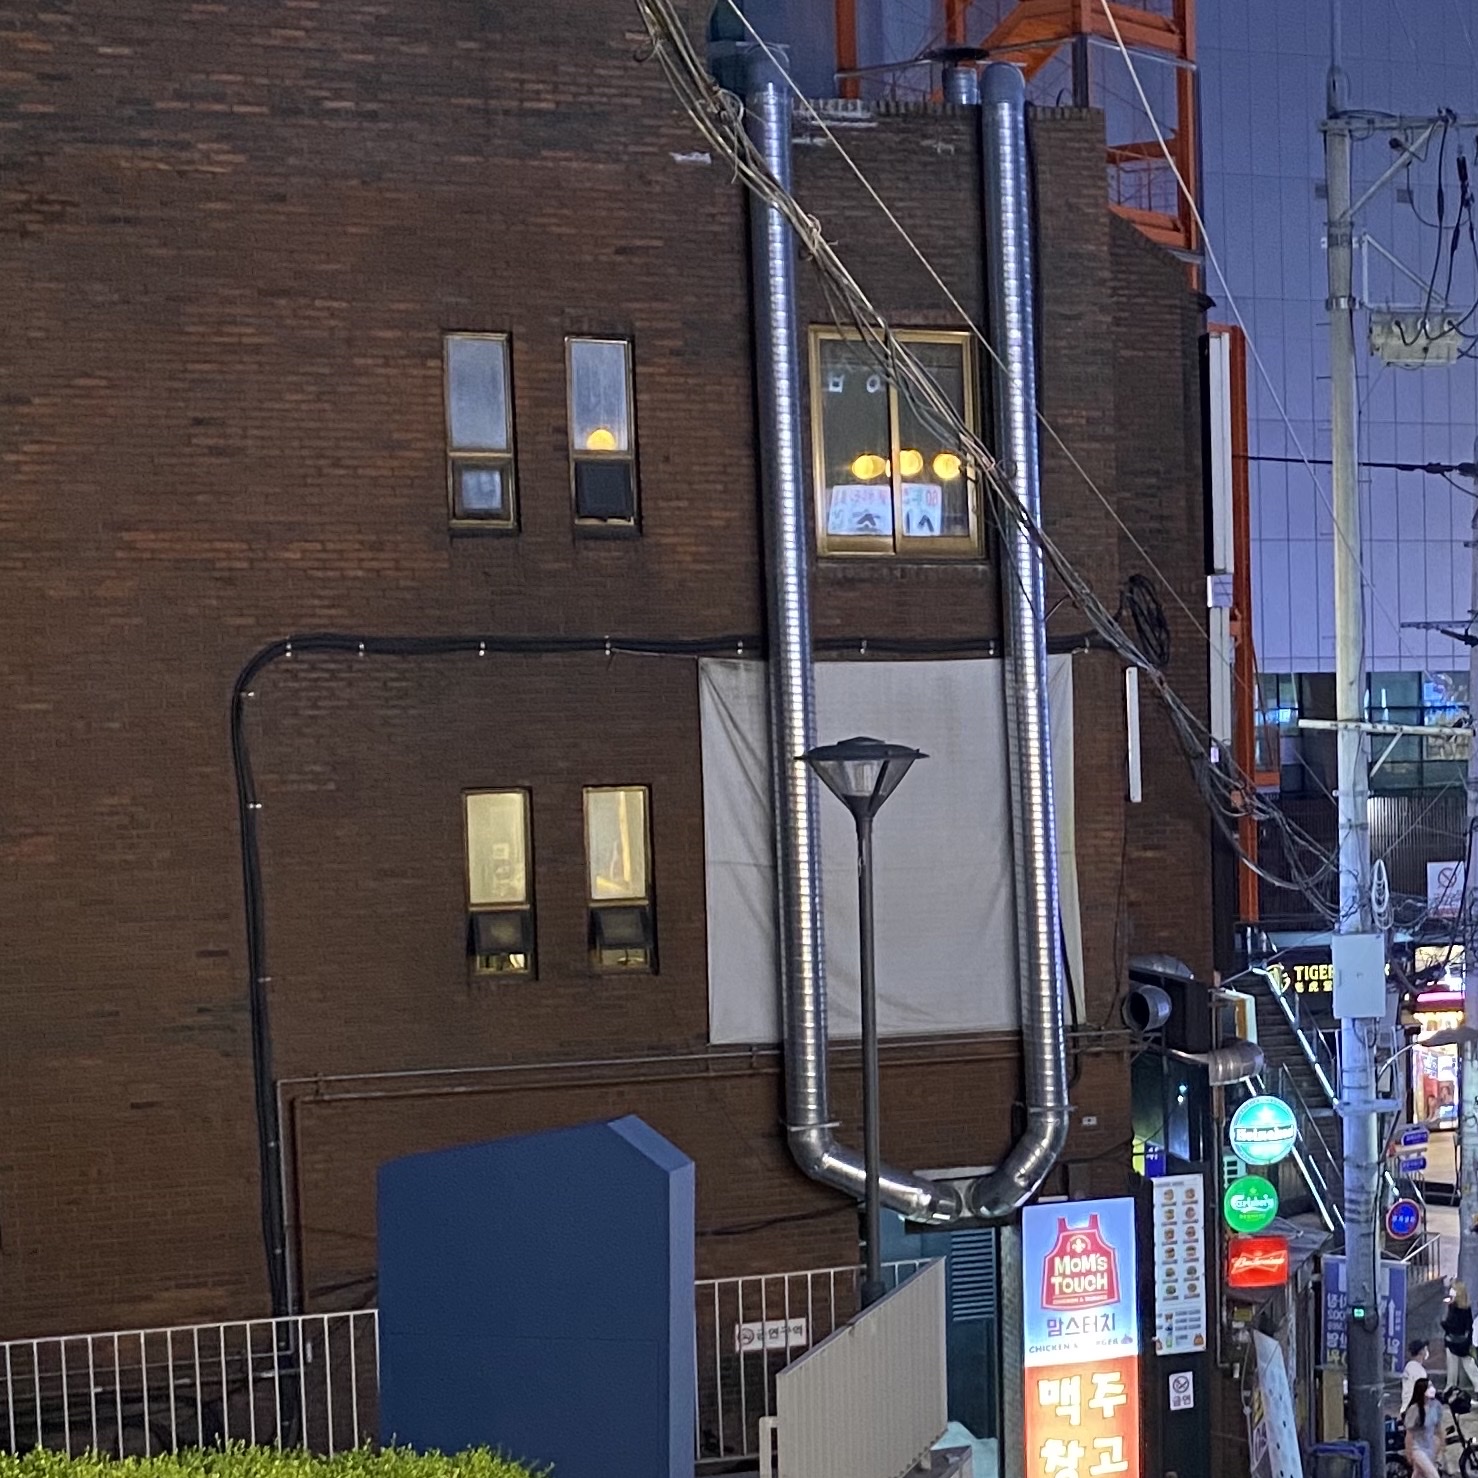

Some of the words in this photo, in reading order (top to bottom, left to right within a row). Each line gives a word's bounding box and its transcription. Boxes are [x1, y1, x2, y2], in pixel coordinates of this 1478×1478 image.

[1051, 1272, 1108, 1296] TOUCH
[1046, 1312, 1116, 1338] 맘스터치
[1029, 1343, 1070, 1354] CHICKEN
[1037, 1371, 1128, 1427] 맥주
